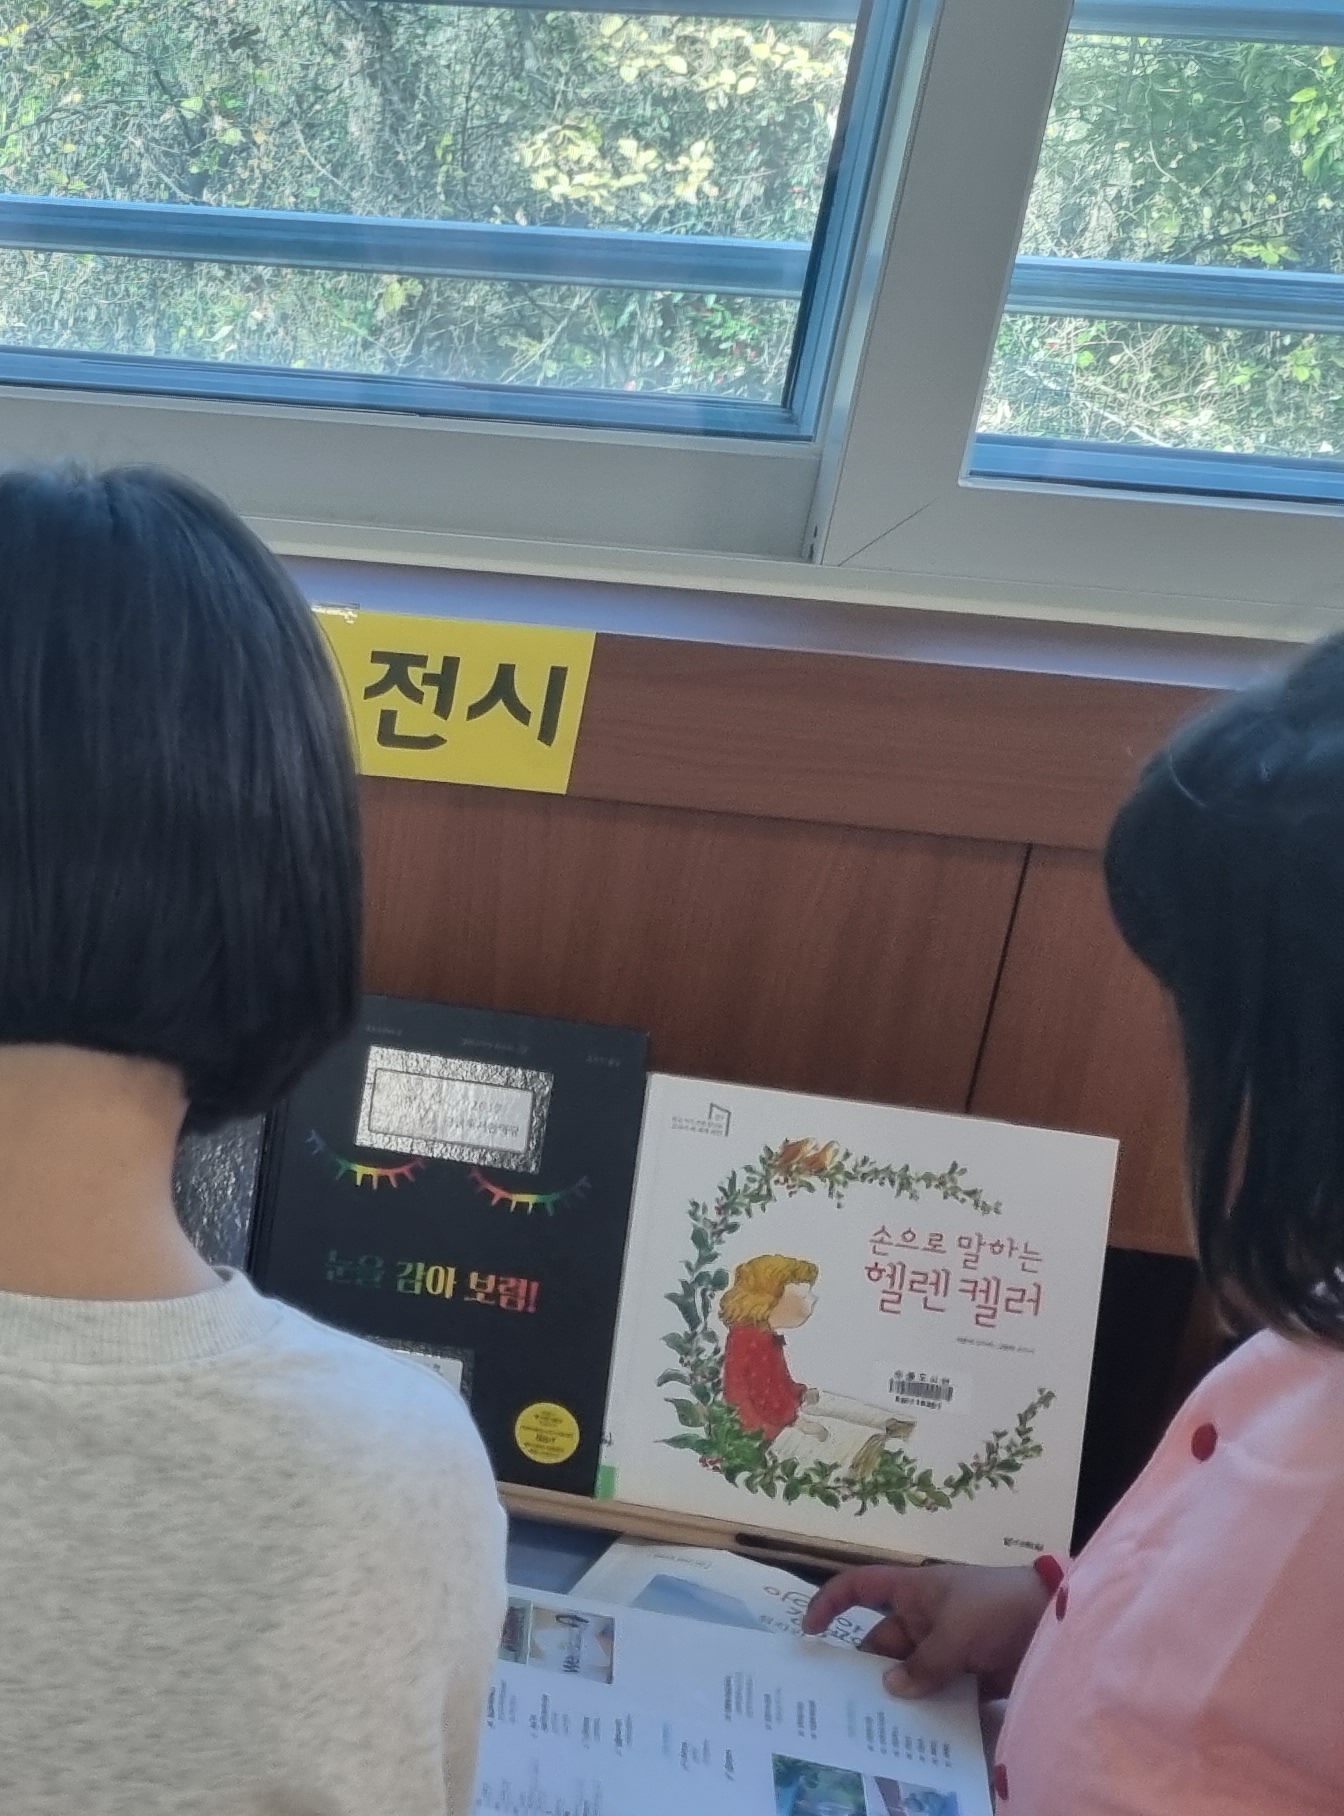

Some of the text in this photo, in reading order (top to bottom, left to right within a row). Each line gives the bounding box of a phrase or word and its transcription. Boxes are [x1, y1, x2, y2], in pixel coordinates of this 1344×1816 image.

[361, 646, 570, 751] 전시
[869, 1225, 1042, 1273] 손으로 말하는
[396, 1261, 457, 1299] 감아
[463, 1270, 540, 1313] 보렴!
[865, 1261, 1042, 1328] 헬렌 켈러
